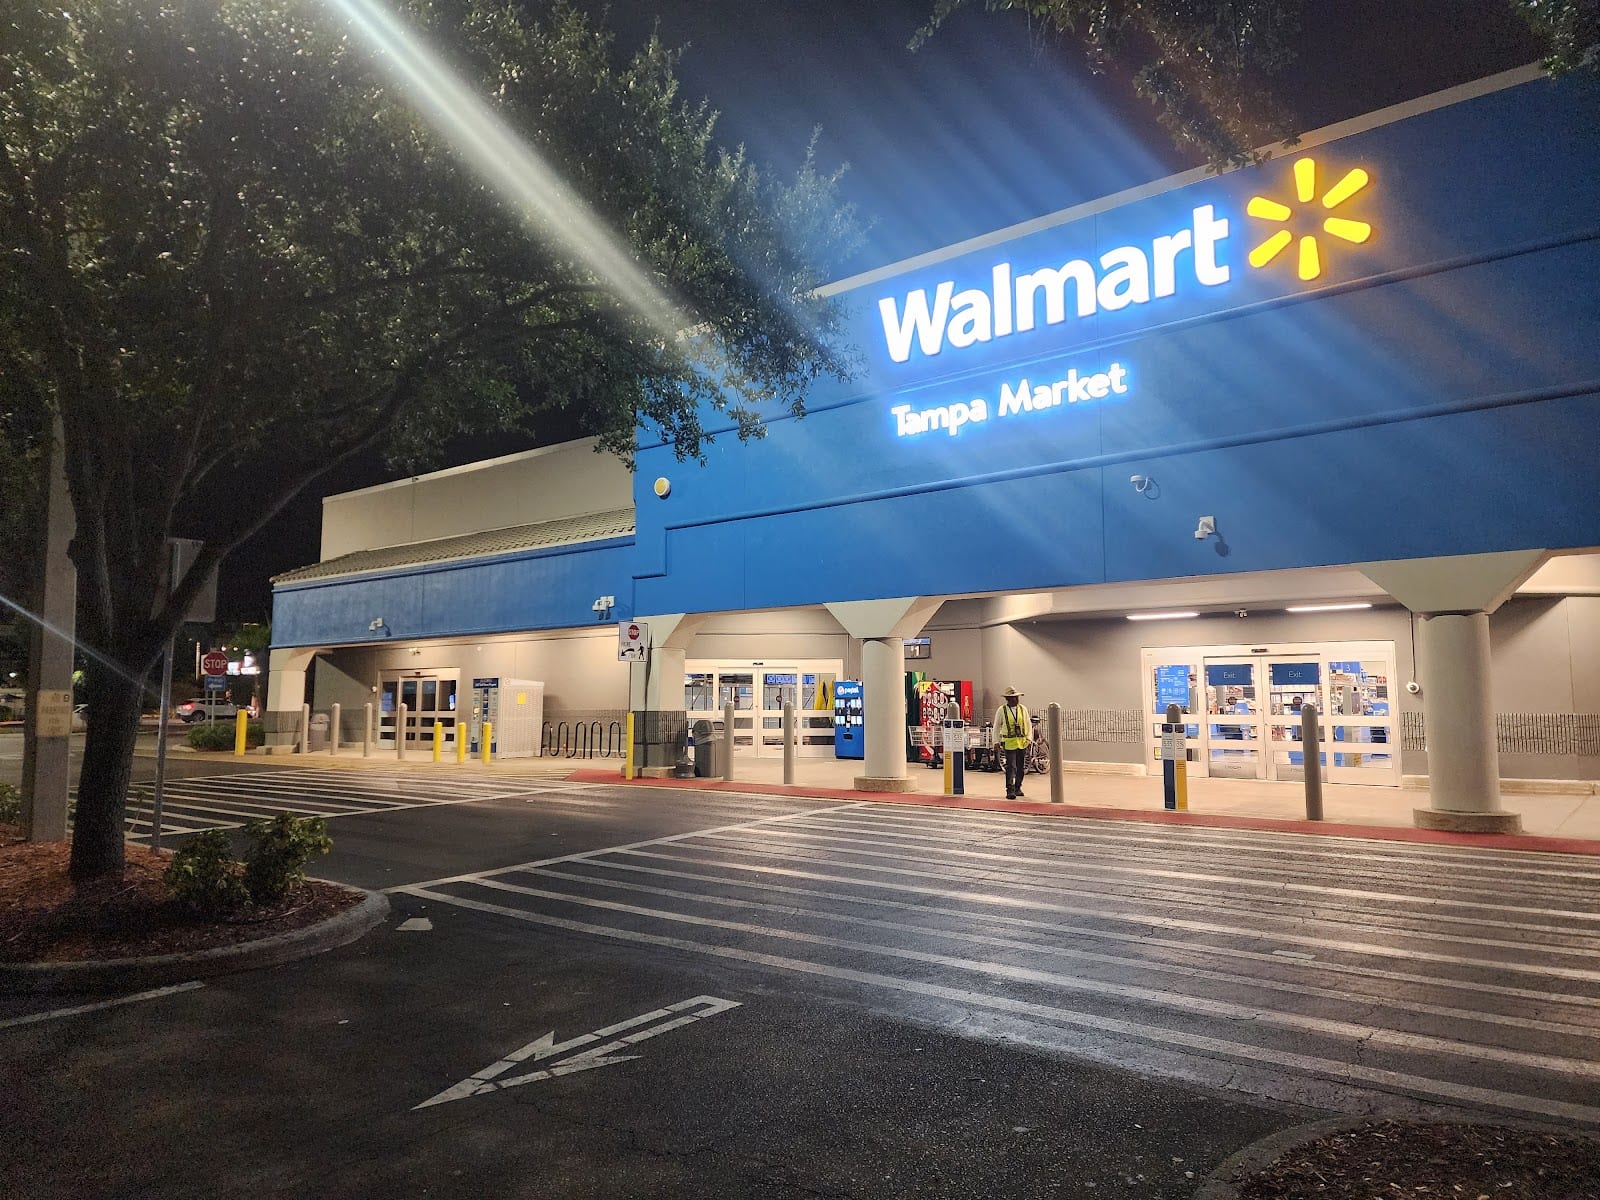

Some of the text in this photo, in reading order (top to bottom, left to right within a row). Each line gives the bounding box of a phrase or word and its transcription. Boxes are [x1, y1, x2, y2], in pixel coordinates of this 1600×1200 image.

[878, 204, 1230, 363] Walmart
[891, 362, 1128, 436] Tampa Market
[204, 659, 227, 668] STOP
[1346, 664, 1351, 672] 3
[1223, 671, 1236, 680] Exit
[1288, 670, 1303, 679] Exit
[844, 686, 860, 695] pepsi
